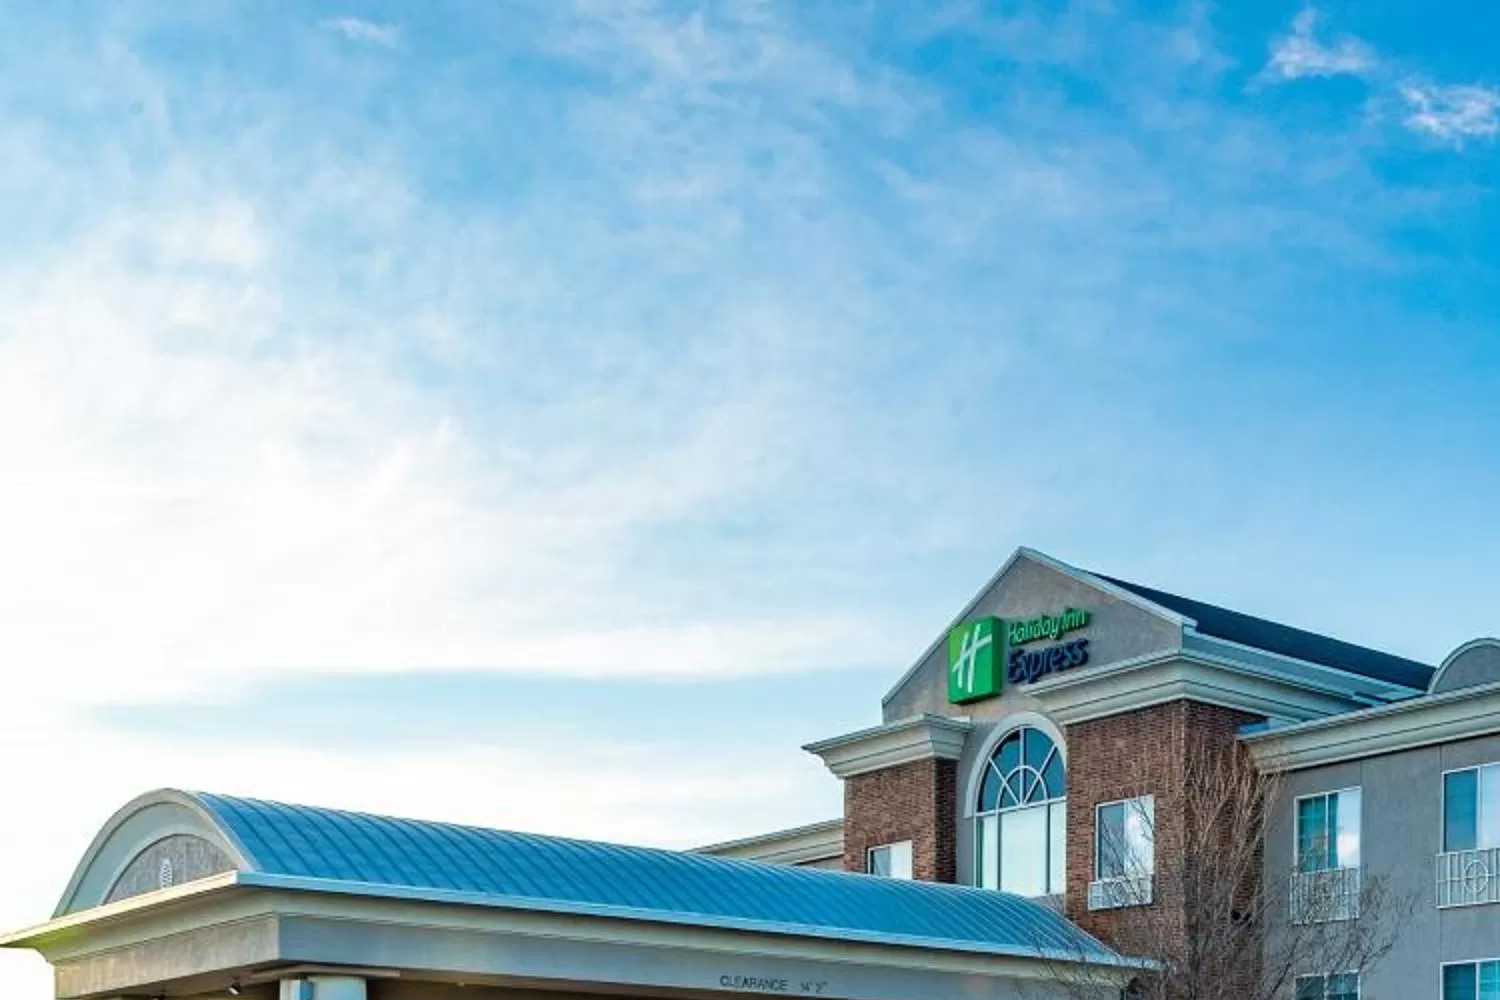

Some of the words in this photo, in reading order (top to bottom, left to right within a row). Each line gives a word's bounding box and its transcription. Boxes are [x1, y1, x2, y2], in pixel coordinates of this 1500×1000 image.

[1008, 613, 1060, 646] Holiday
[1061, 607, 1088, 632] Inn
[1007, 637, 1089, 684] Express
[719, 974, 789, 992] CLEARANCE
